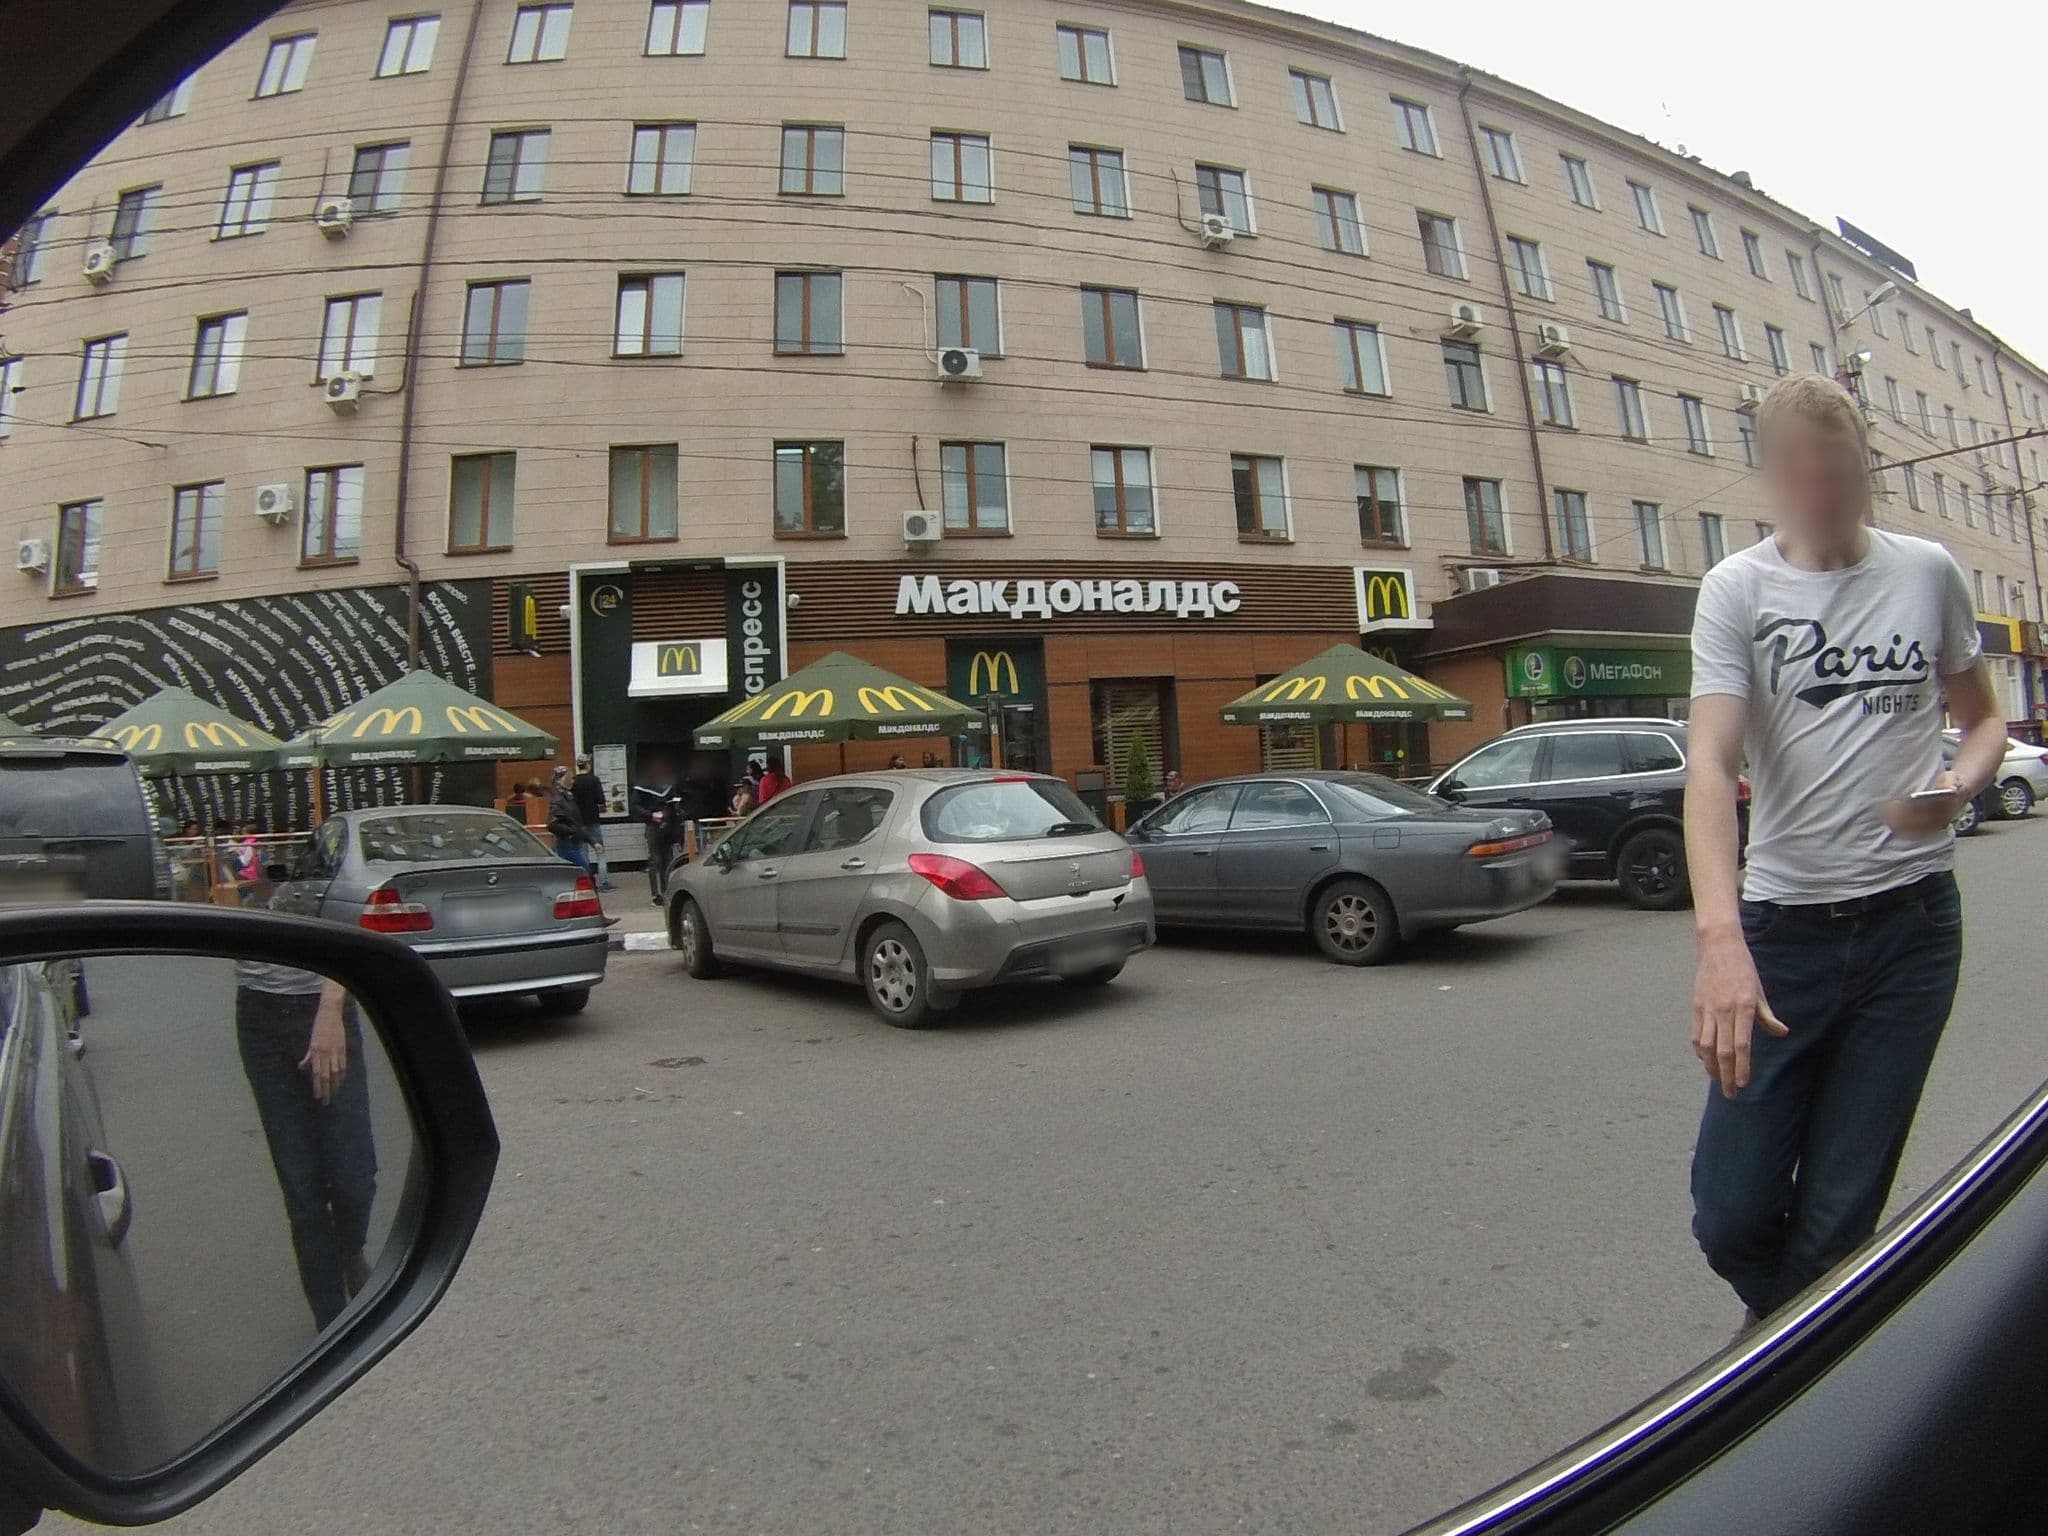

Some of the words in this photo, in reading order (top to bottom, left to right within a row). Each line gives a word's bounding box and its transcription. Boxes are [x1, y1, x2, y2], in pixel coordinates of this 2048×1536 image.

[427, 591, 456, 629] ВСЕГДА
[895, 574, 1241, 619] Макдоналдс
[306, 635, 338, 672] ВСЕГДА
[332, 670, 353, 706] ВМЕСТ
[1753, 617, 1930, 696] Paris
[1861, 693, 1921, 716] NIGHTS
[758, 728, 825, 742] Макдоналдс
[878, 722, 941, 735] Макдоналдс
